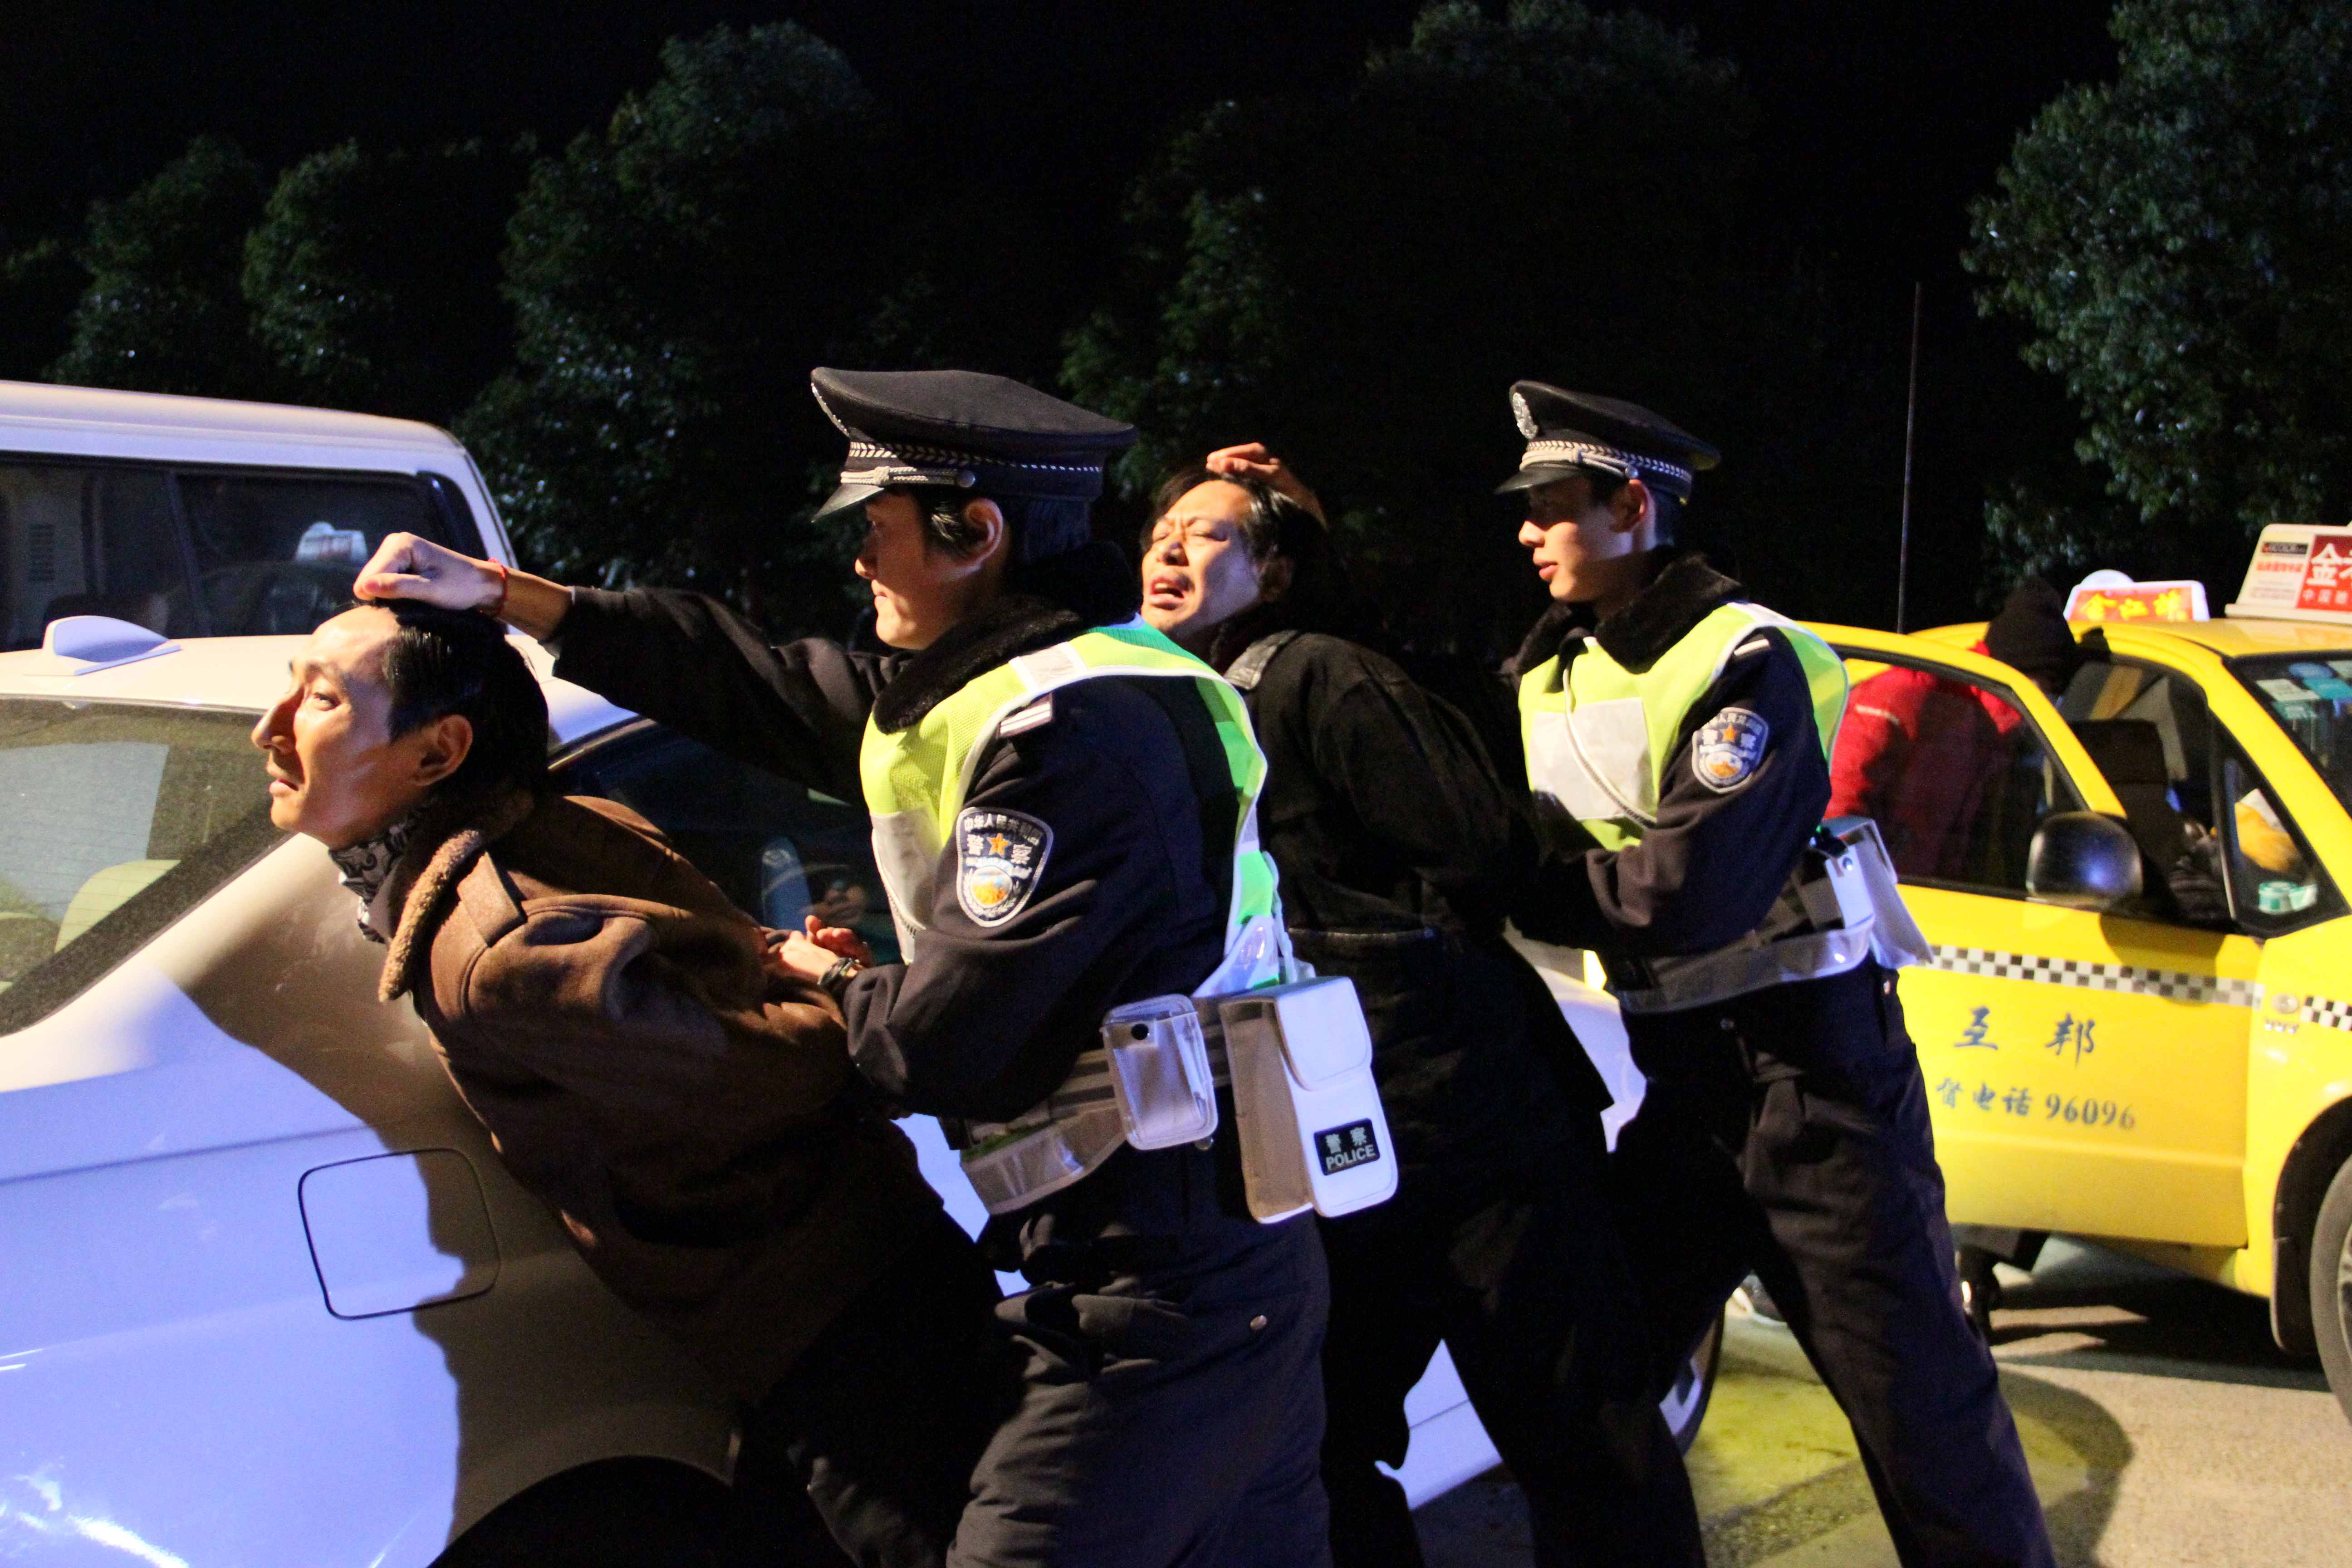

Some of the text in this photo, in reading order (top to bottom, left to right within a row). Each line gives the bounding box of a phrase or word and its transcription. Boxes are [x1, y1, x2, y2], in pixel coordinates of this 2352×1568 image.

[2306, 543, 2352, 587] 金
[2046, 1093, 2136, 1129] 96096
[1325, 1127, 1367, 1154] 警察
[1325, 1144, 1376, 1170] POLICE
